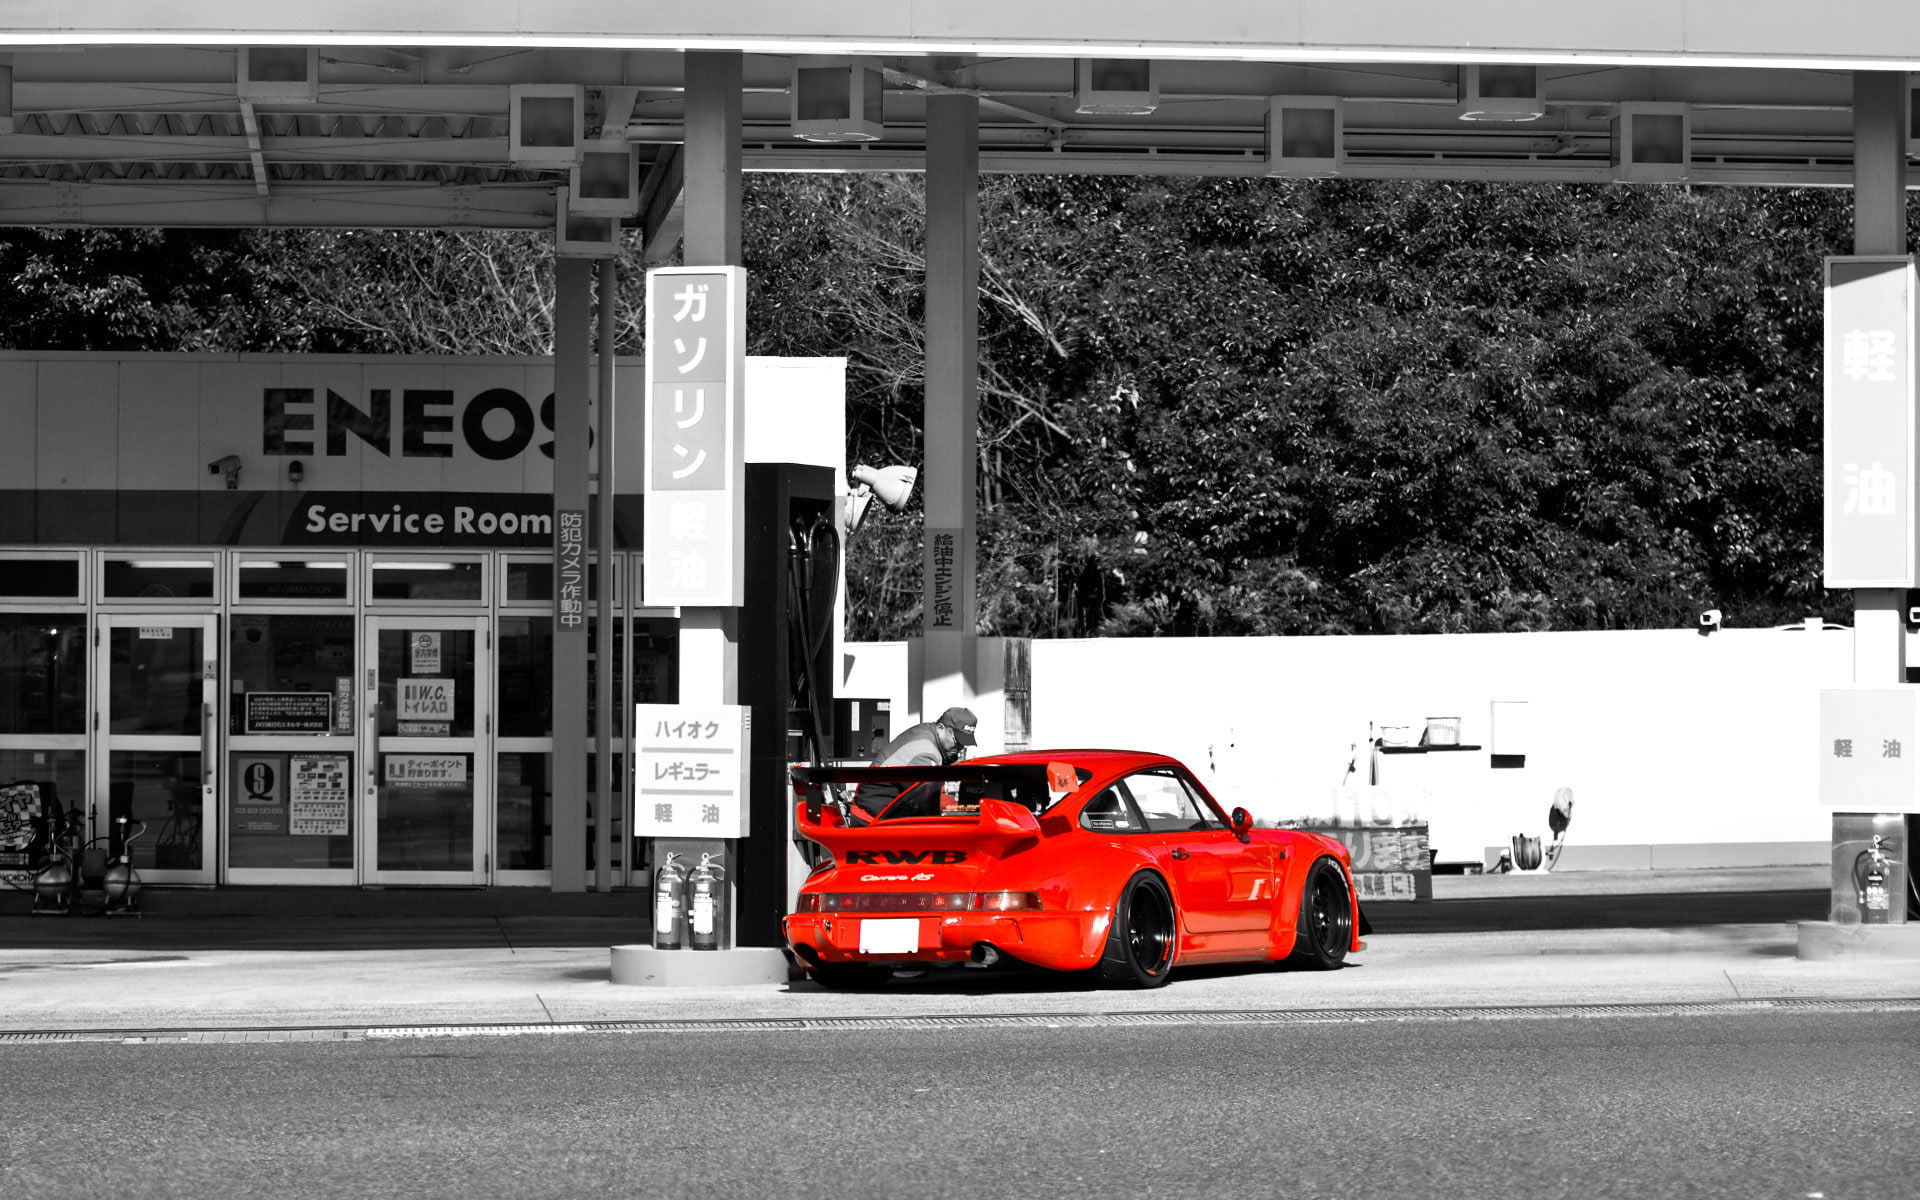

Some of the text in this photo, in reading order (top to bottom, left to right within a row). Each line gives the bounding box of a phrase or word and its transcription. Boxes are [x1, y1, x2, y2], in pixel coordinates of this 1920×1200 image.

[671, 283, 709, 480] ガソリン
[1843, 328, 1896, 515] 軽油
[306, 505, 552, 534] Service Room
[670, 500, 708, 589] 軽油
[560, 513, 582, 628] 防犯カメラ作動中
[932, 533, 954, 628] 給油中エンジン停止
[419, 685, 447, 700] W.C.
[404, 701, 448, 714] トイレ入口
[654, 720, 720, 740] ハイオク
[407, 759, 463, 769] ティーポイント
[653, 761, 721, 782] レギュラー
[845, 850, 969, 865] RWB
